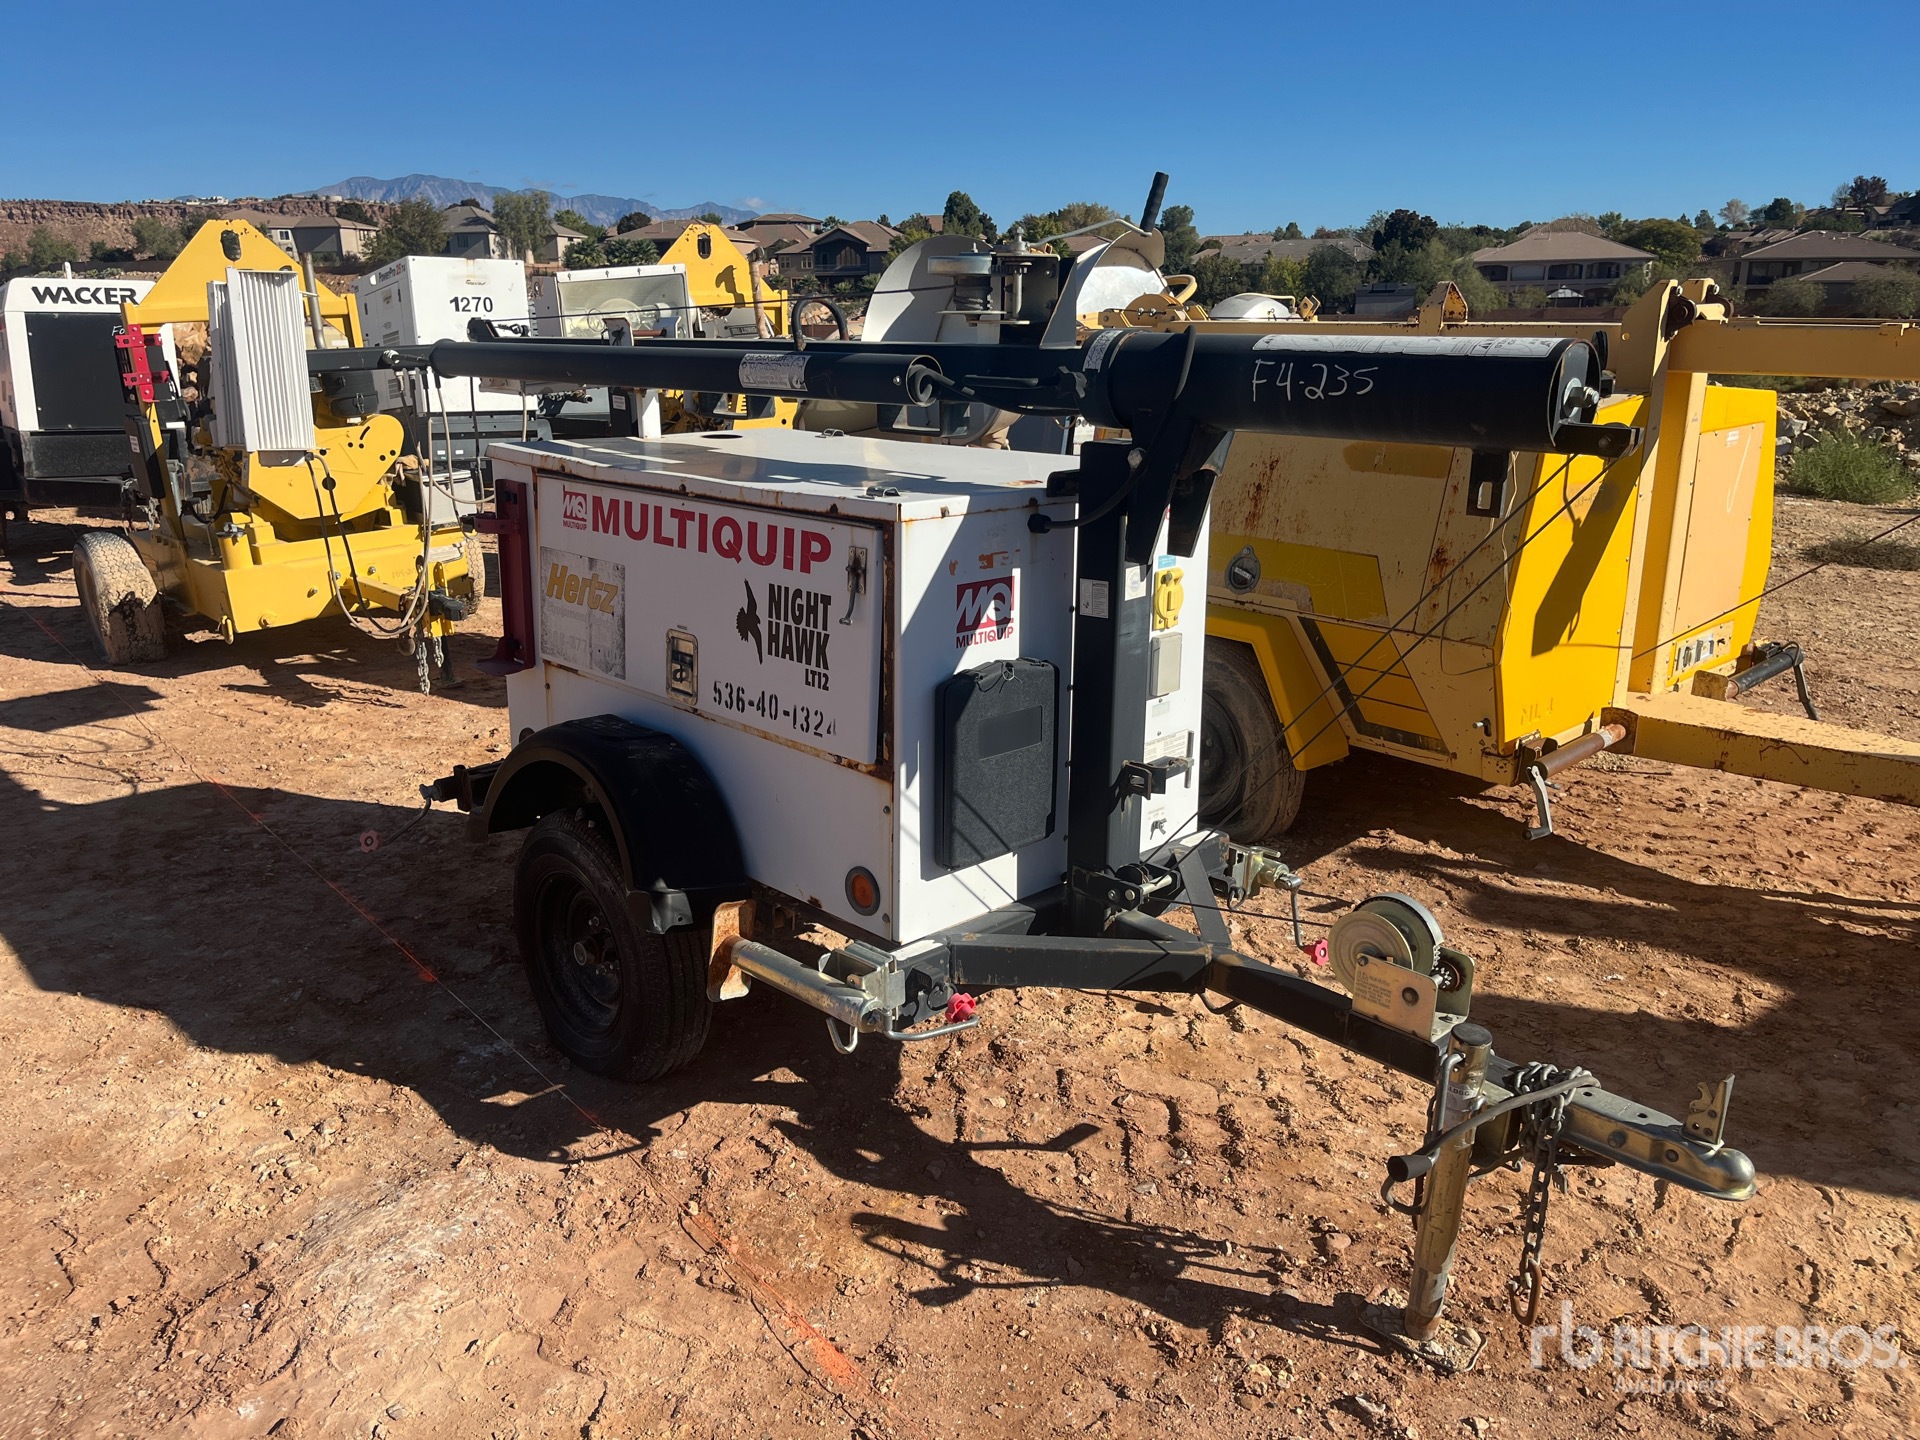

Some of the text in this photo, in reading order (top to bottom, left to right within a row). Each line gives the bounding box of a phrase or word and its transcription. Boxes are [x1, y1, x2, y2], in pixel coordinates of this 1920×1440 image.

[31, 286, 139, 305] WACKER
[449, 296, 493, 313] 1270
[1252, 358, 1379, 402] F4-235
[563, 490, 588, 522] MQ
[563, 520, 588, 531] MULTIQUIP
[592, 495, 832, 574] MULTIQUIP
[546, 562, 619, 616] Hertz
[768, 583, 832, 631] NIGHT
[956, 577, 1014, 633] MQ
[767, 620, 830, 671] HAWK
[955, 627, 1014, 649] MULTIQUIP
[804, 668, 829, 691] LT12
